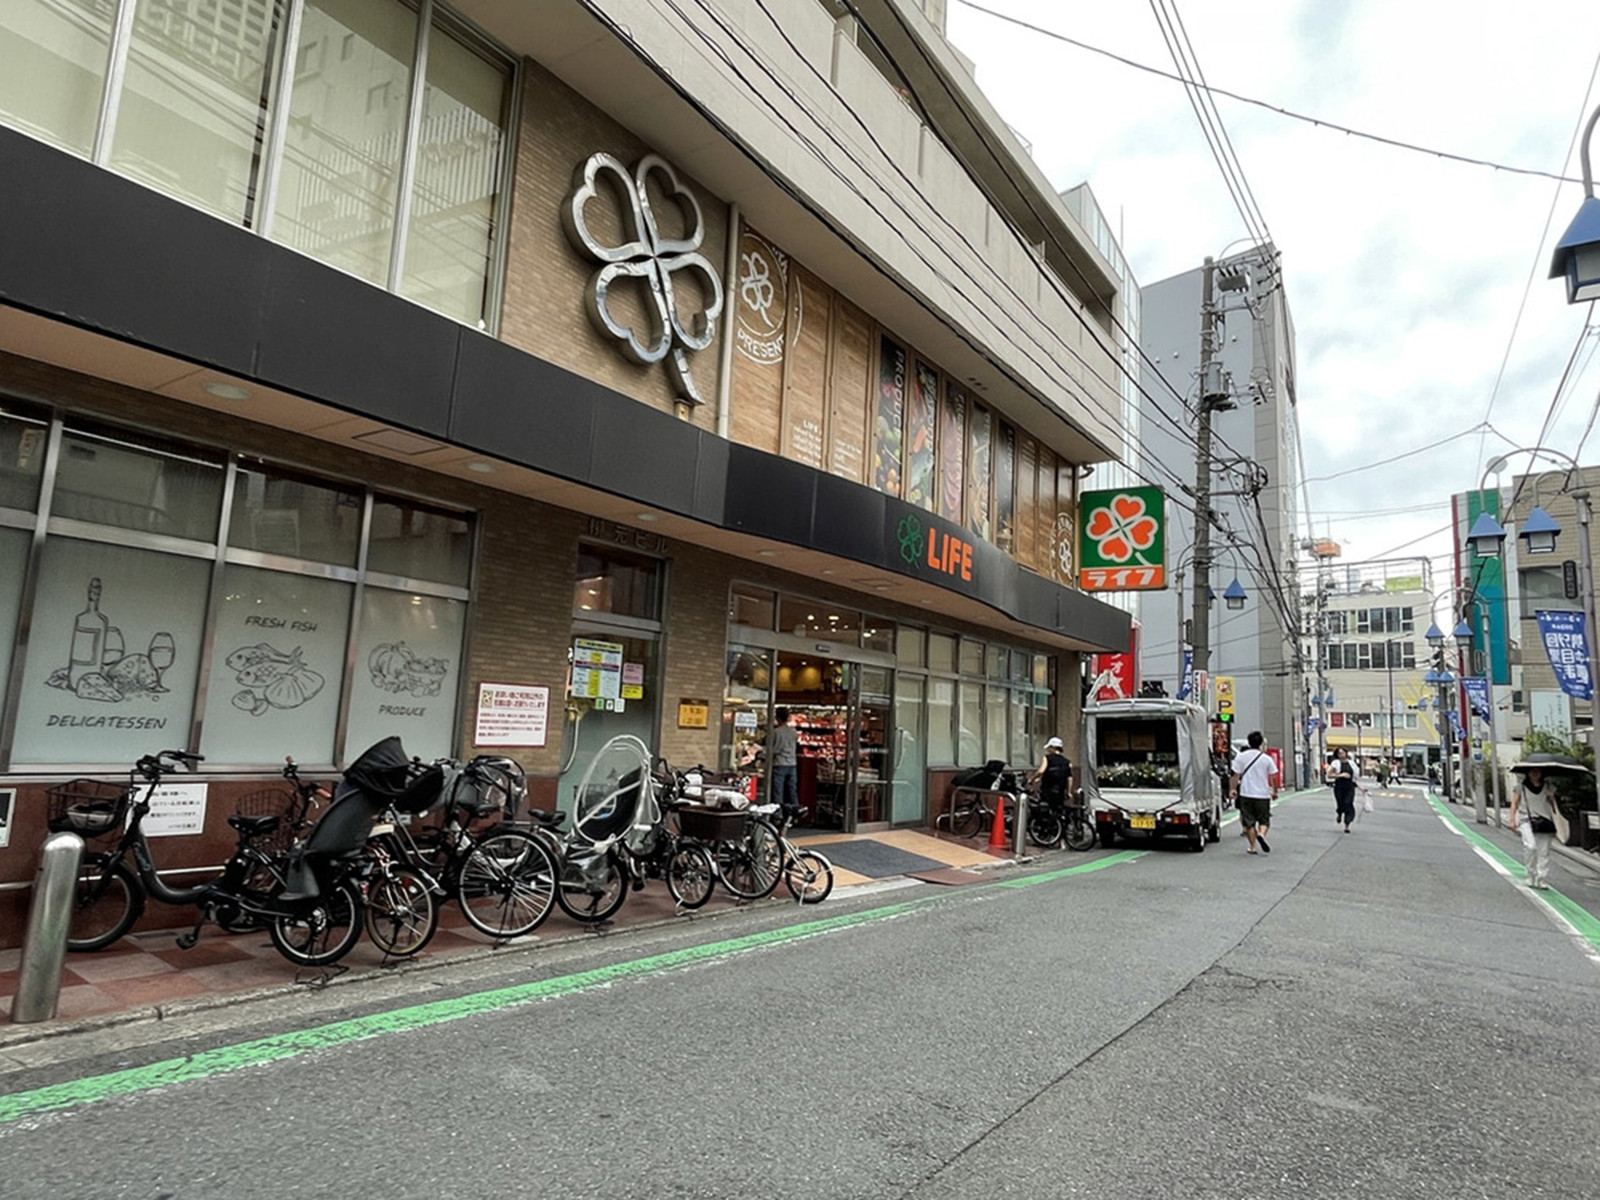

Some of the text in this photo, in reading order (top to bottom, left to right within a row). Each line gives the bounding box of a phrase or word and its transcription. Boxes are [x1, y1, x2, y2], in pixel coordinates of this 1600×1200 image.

[737, 328, 784, 358] PRESENT
[892, 351, 904, 437] PRODUCE
[928, 528, 972, 582] LIFE
[1088, 569, 1155, 588] ライフ
[245, 616, 318, 632] FRESH FISH
[378, 704, 426, 716] PRODUCE
[1218, 700, 1232, 712] P
[46, 715, 167, 729] DELICATESSEN
